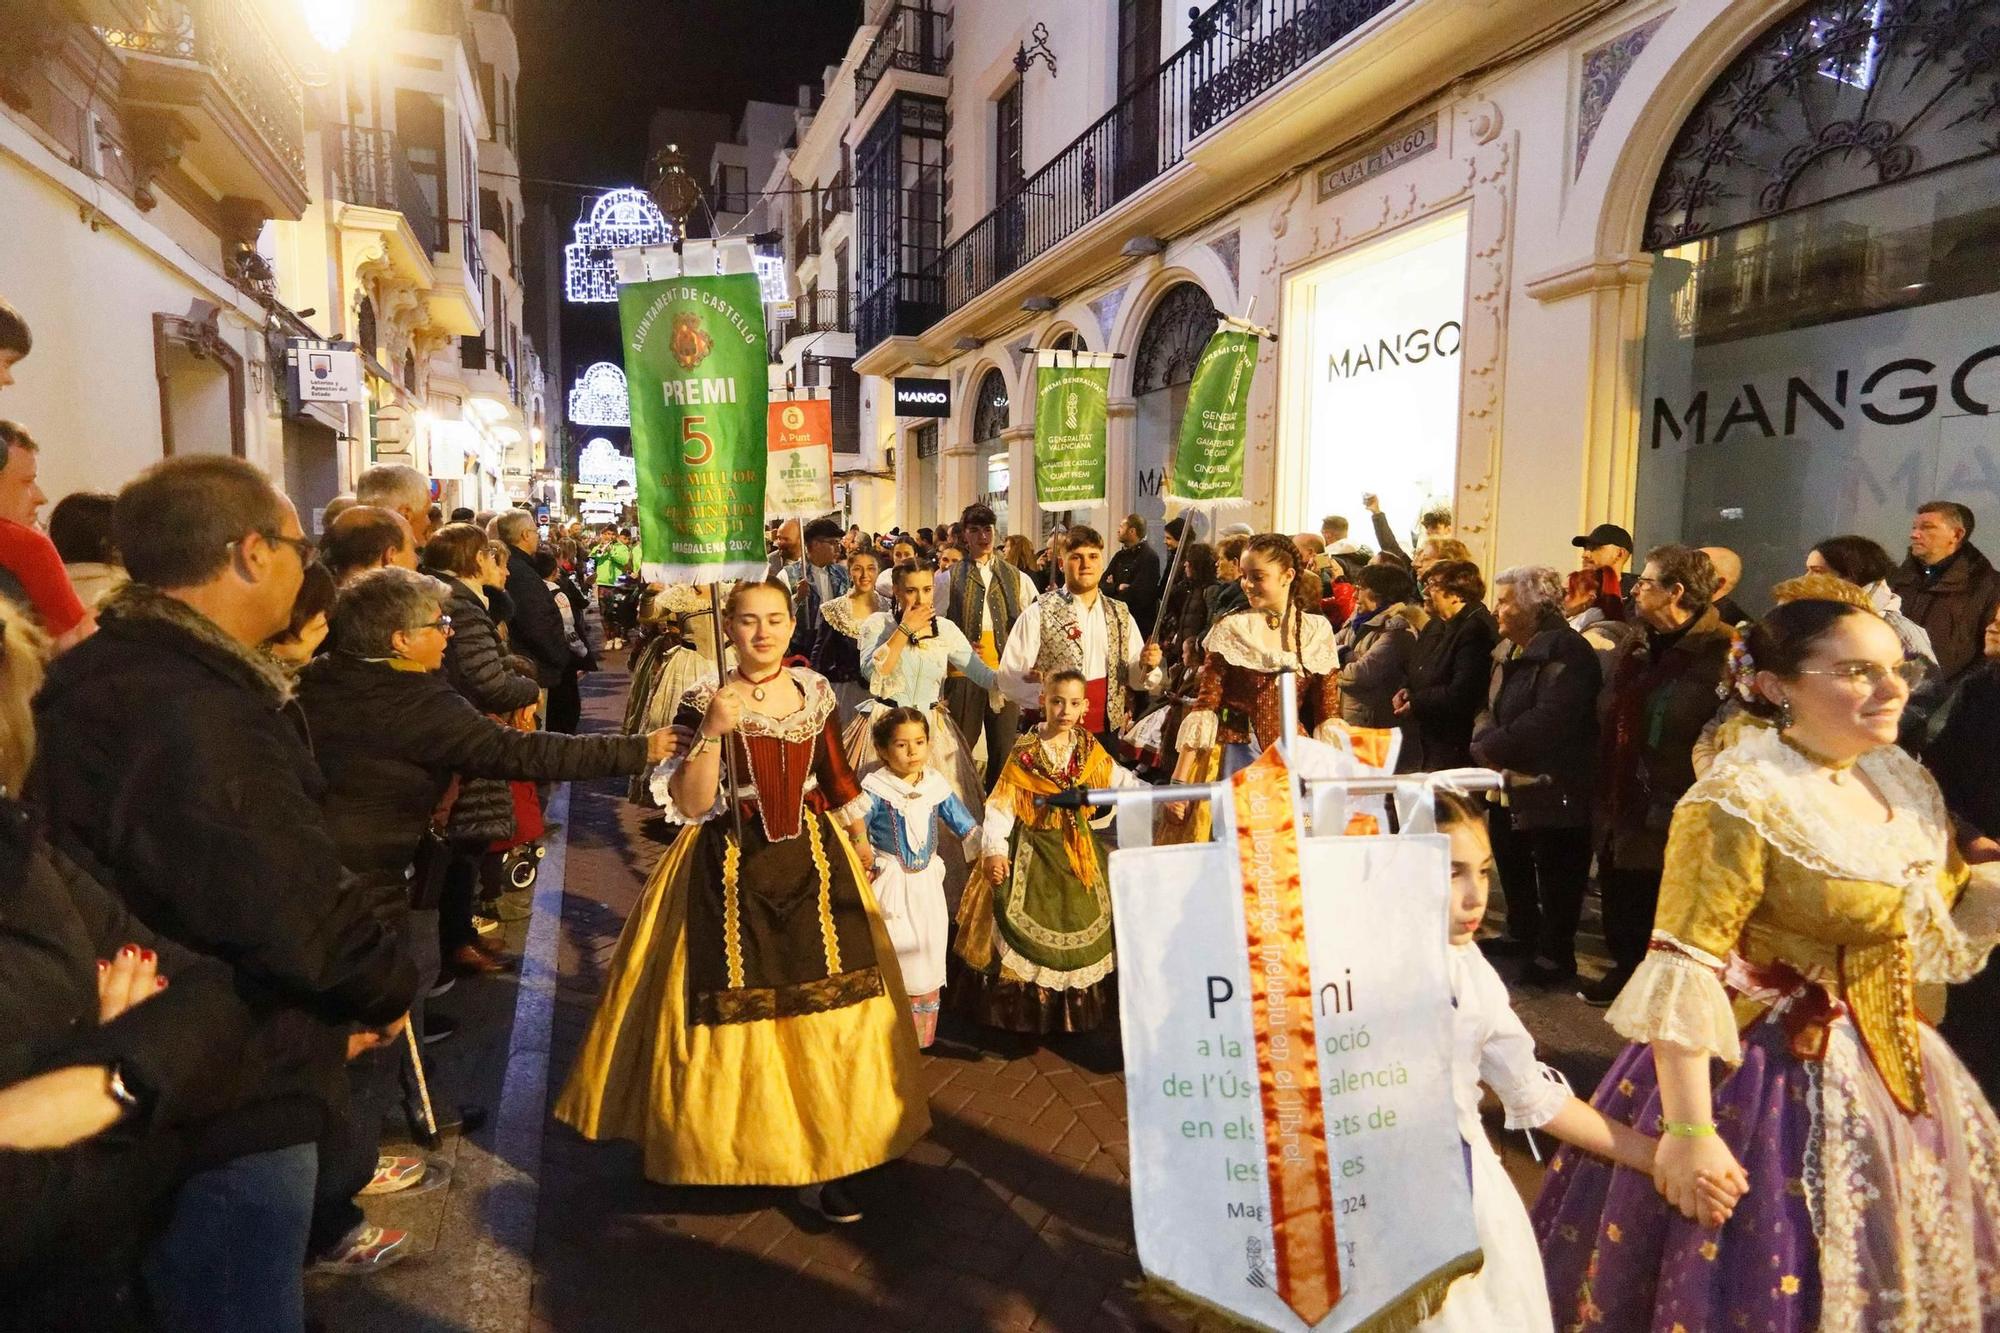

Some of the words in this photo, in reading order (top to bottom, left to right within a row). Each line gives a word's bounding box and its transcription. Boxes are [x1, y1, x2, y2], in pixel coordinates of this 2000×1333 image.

[632, 287, 677, 352] AJUNTAMENT
[681, 287, 697, 300] DE
[702, 292, 757, 344] CASTELLÓ
[1329, 321, 1460, 382] MANGO
[662, 377, 737, 407] PREMI
[898, 392, 947, 403] MANGO
[682, 416, 714, 466] 5
[789, 433, 811, 442] Punt
[1048, 434, 1092, 443] GENERALITAT
[1049, 442, 1091, 450] VALENCIANA
[780, 468, 816, 479] PREMI
[672, 541, 726, 553] MAGDALENA
[1198, 1040, 1210, 1056] a
[1220, 1034, 1241, 1057] la
[1163, 1073, 1192, 1097] de
[1329, 1061, 1408, 1096] alencià
[1182, 1120, 1213, 1138] en
[1368, 1106, 1396, 1129] de
